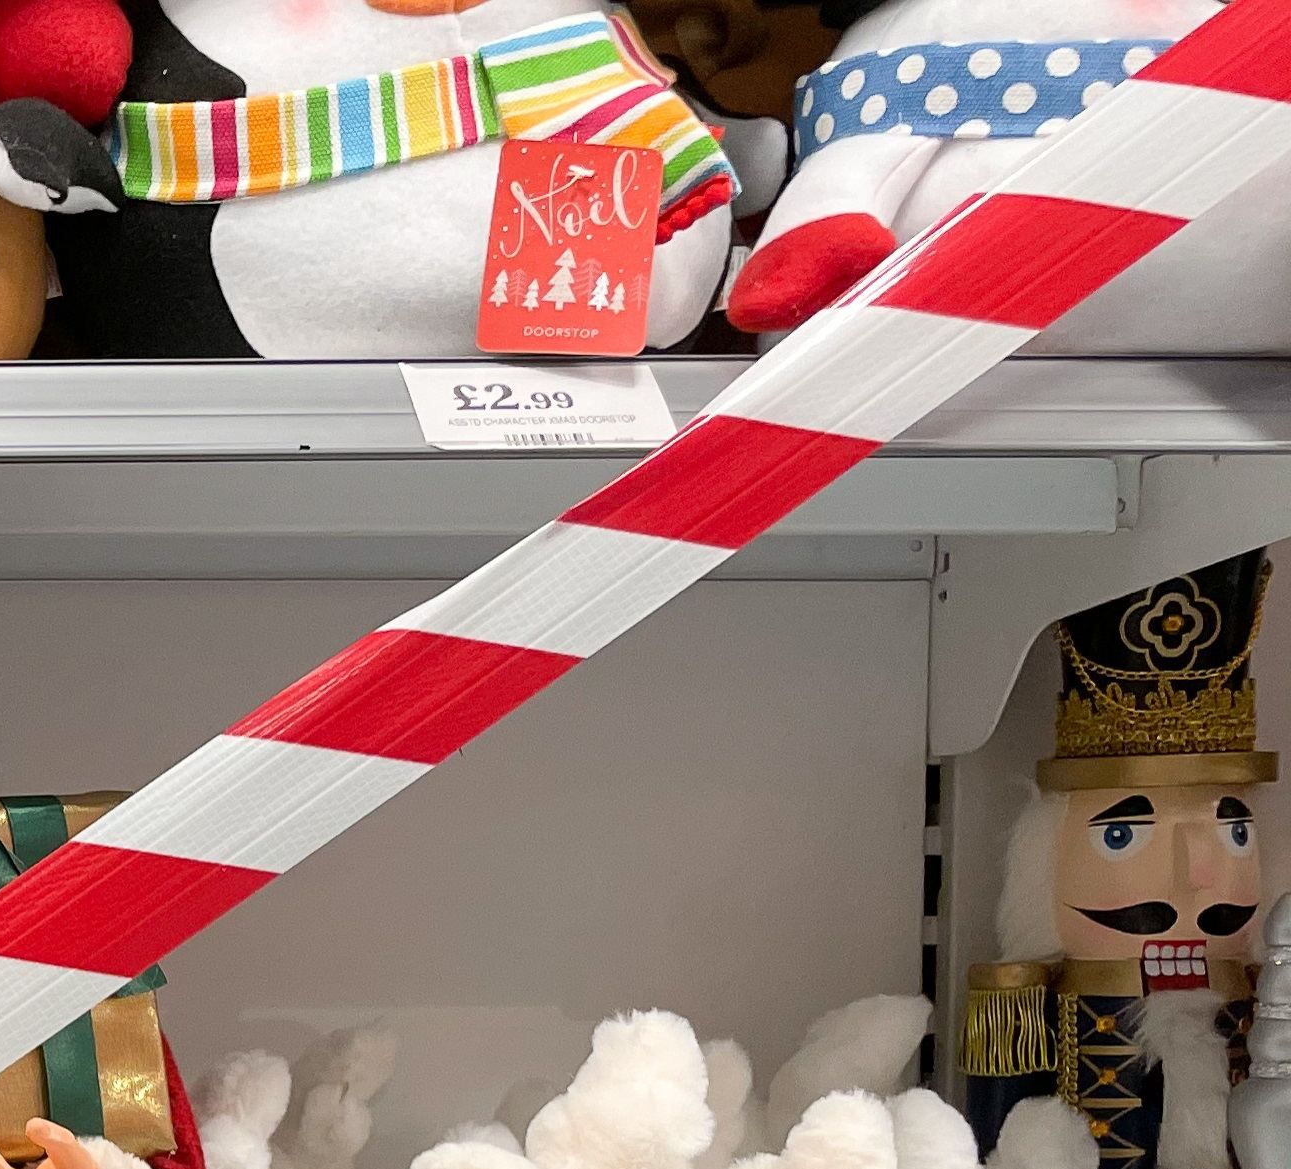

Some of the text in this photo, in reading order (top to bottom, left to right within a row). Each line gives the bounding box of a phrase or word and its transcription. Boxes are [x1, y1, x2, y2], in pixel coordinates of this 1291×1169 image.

[500, 150, 647, 258] Noël
[523, 326, 599, 339] DOORSTOP
[453, 383, 574, 411] £2.99
[483, 416, 546, 426] CHARACTER
[549, 416, 577, 425] XMAS
[579, 414, 636, 425] DOORSTOP
